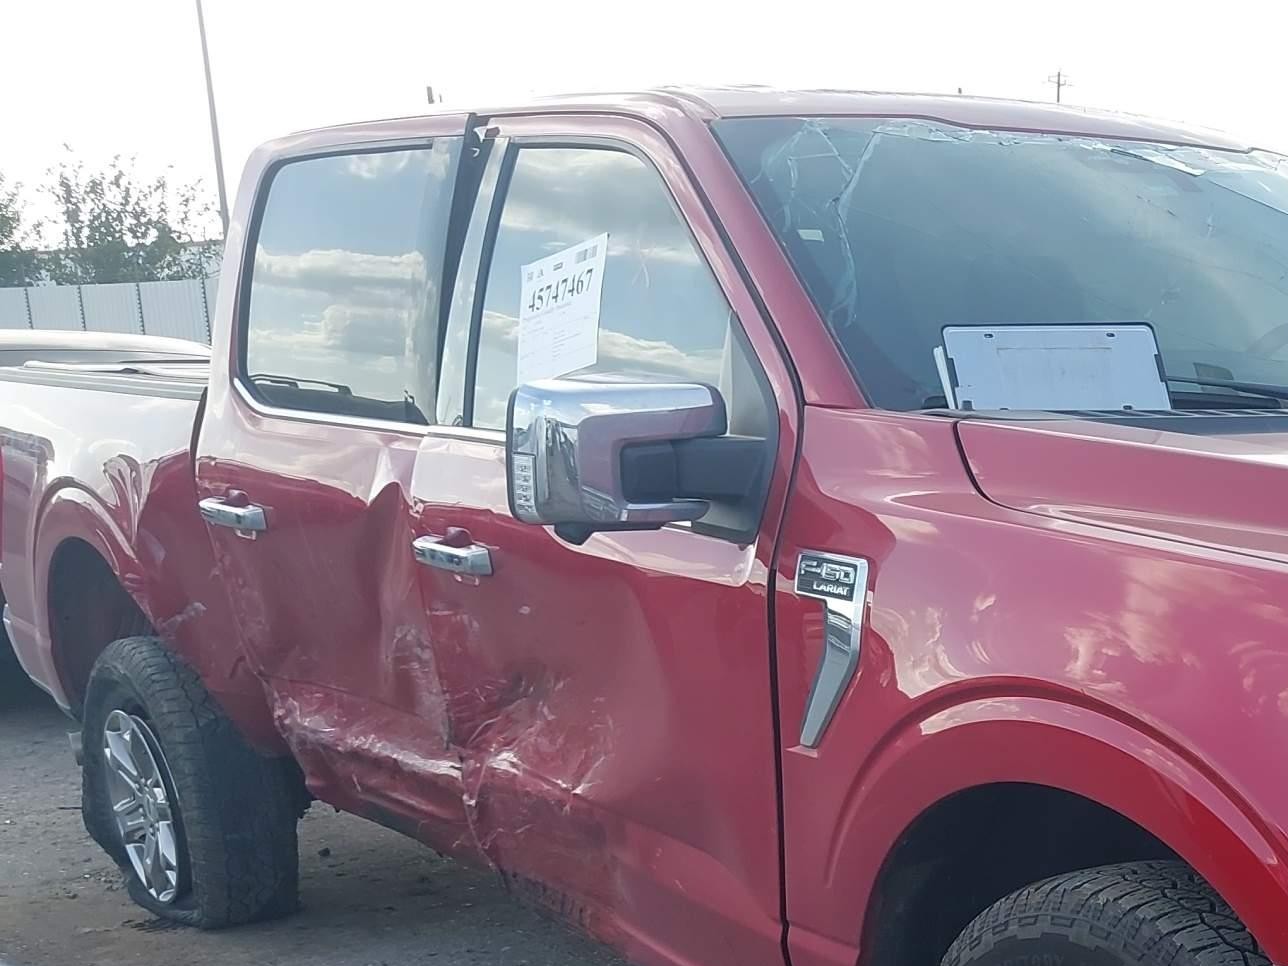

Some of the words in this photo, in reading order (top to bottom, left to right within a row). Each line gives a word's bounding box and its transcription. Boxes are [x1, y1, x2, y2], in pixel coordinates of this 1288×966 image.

[528, 267, 595, 313] 45747467
[800, 560, 856, 584] F-150
[812, 580, 850, 596] LARIAT
